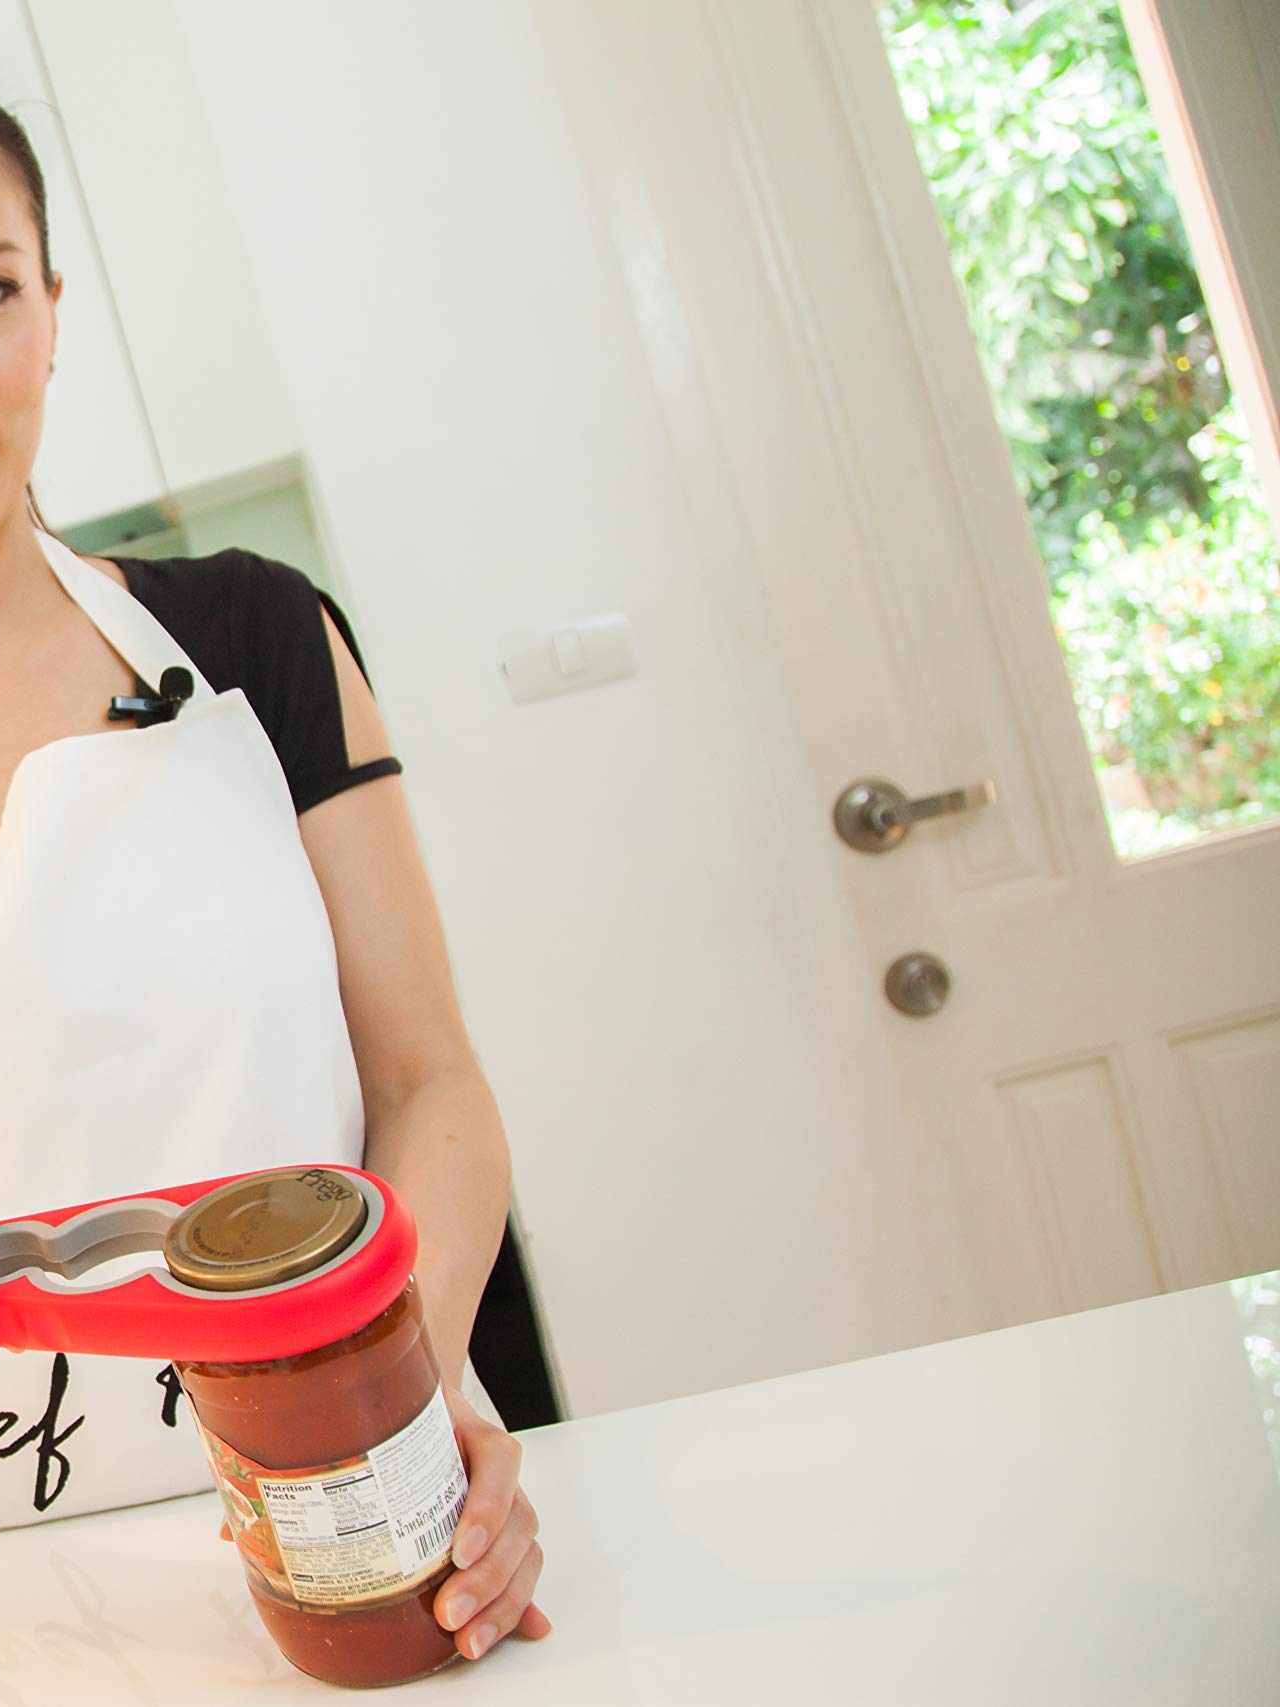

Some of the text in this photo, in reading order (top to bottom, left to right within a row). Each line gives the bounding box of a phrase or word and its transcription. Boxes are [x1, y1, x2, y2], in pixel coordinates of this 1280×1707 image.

[296, 1168, 354, 1202] Prego
[263, 1483, 313, 1493] Nutrition
[265, 1492, 297, 1500] Facts
